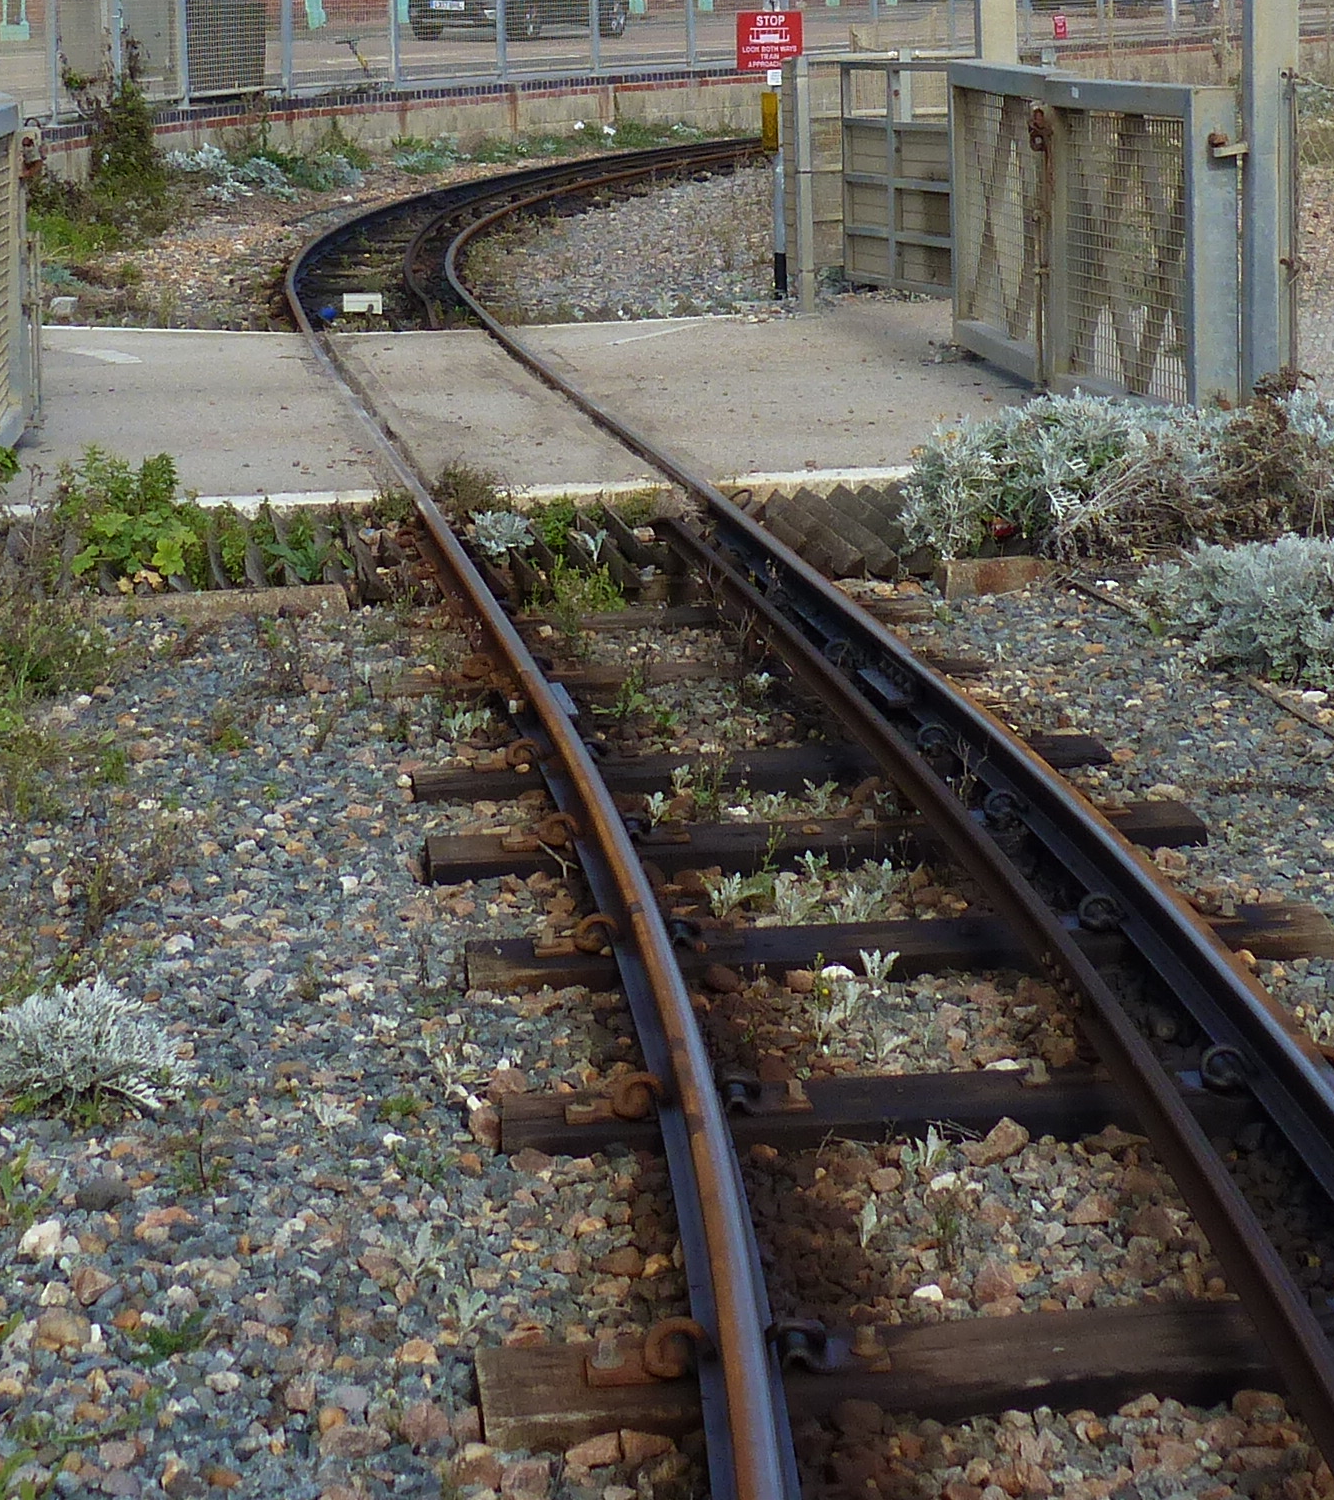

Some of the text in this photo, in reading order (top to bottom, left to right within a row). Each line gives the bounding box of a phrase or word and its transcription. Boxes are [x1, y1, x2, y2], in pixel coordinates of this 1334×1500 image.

[756, 15, 785, 26] STOP
[742, 46, 760, 54] LOOK
[761, 45, 779, 53] BOTH
